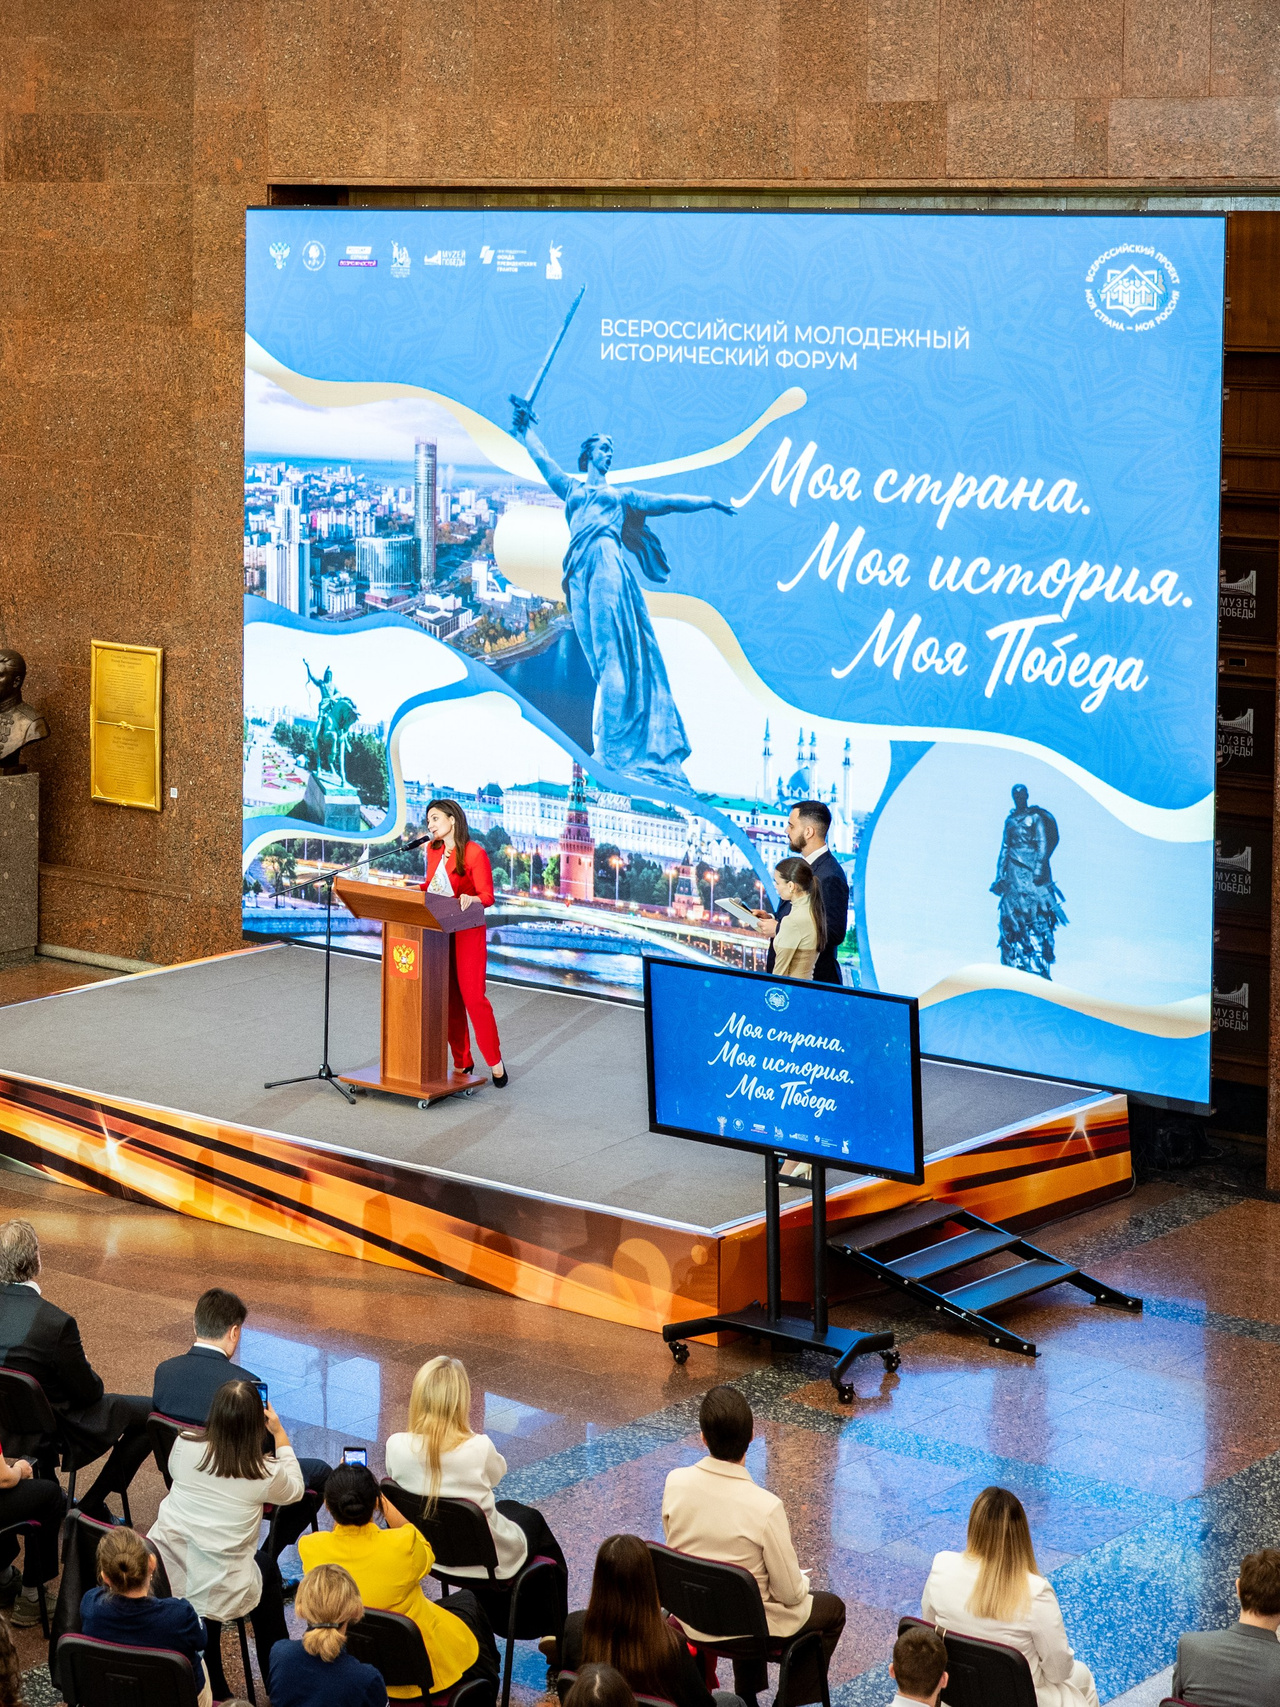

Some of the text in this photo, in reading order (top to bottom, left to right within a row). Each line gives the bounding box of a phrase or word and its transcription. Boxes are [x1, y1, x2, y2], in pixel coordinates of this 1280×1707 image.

[1085, 243, 1180, 284] ВСЕРОССИЙСКИЙ ПРОЕКТ
[1085, 289, 1097, 310] МОЯ
[1094, 309, 1125, 331] СТРАНА
[1135, 321, 1155, 332] МОЯ
[1155, 290, 1180, 324] РОССИЯ
[601, 319, 970, 350] ВСЕРОССИЙСКИЙ МОЛОДЕЖНЫЙ
[601, 342, 857, 371] ИСТОРИЧЕСКИЙ ФОРУМ
[730, 437, 1091, 531] Моя страна.
[777, 522, 1194, 618] Моя история.
[1220, 597, 1256, 608] МУЗЕЙ
[1220, 607, 1256, 619] ПОБЕДЫ
[832, 608, 1149, 713] Моя Победа
[1215, 871, 1251, 884] МУЗЕЙ
[1215, 881, 1251, 895] ПОБЕДЫ
[714, 1012, 845, 1053] Моя страна.
[1216, 1017, 1249, 1031] ОБЕДЫ
[707, 1041, 854, 1085] Моя история.
[725, 1074, 837, 1118] Моя Победа
